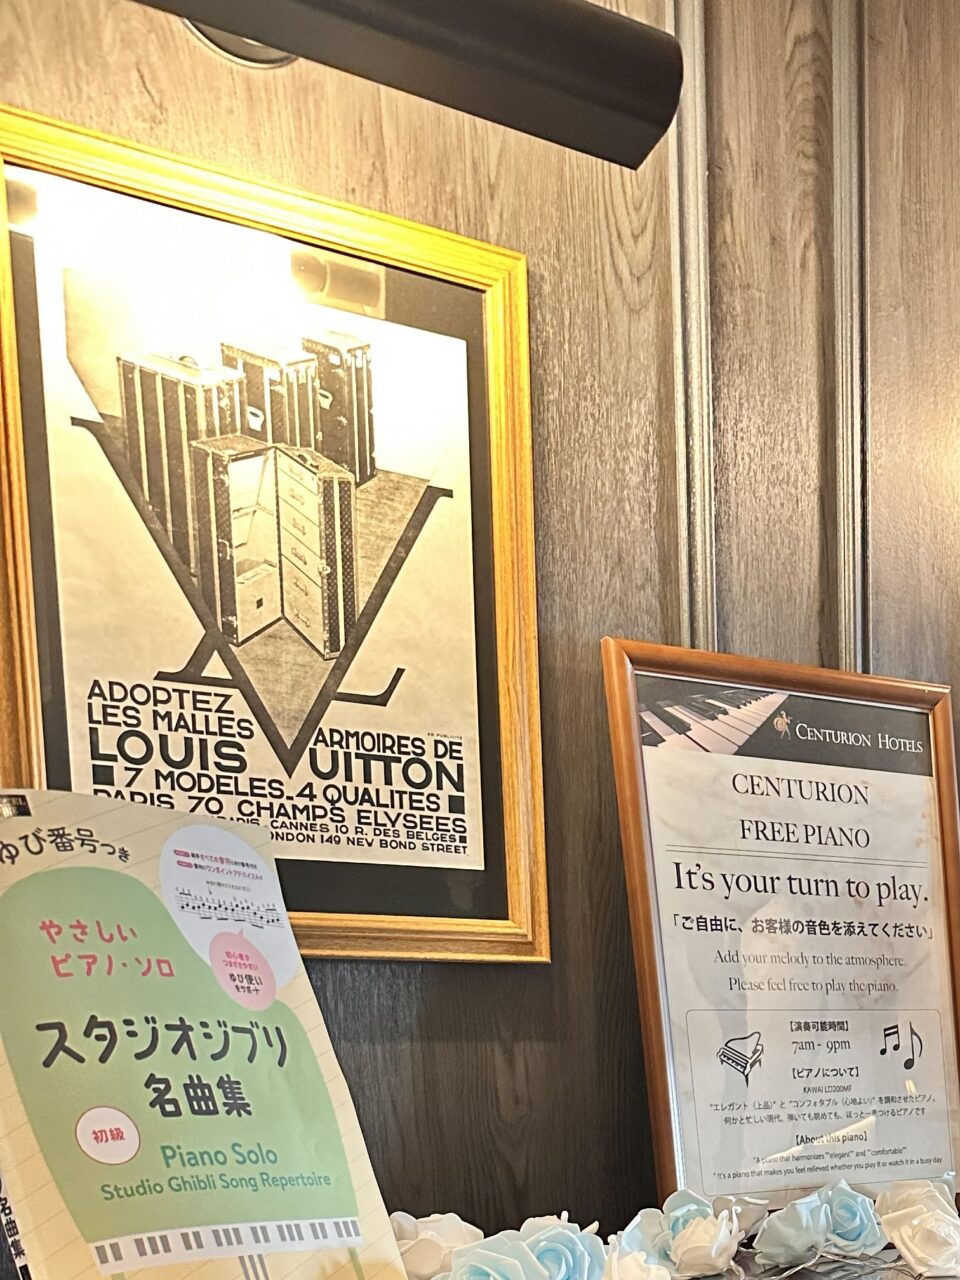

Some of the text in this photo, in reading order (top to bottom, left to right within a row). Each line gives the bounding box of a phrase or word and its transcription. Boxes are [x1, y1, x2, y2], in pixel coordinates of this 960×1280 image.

[88, 679, 235, 714] ADOPTEZ
[88, 702, 255, 740] LES MALLES
[89, 726, 249, 774] LOUIS
[313, 727, 464, 761] ARMOIRES DE
[795, 722, 923, 753] CENTURION HOTELS
[124, 767, 143, 788] 7
[322, 784, 441, 813] QUALITES
[731, 773, 869, 806] CENTURION
[187, 795, 224, 815] 70
[237, 798, 346, 824] CHAMPS
[356, 808, 468, 835] ELYSEES
[270, 819, 329, 833] CANNES
[335, 824, 349, 835] 10
[354, 825, 368, 836] R.
[373, 827, 401, 839] DES
[406, 830, 457, 843] BELGES
[320, 834, 341, 845] 149
[379, 838, 417, 851] BOND
[421, 842, 468, 855] STREET
[739, 818, 871, 849] FREE PIANO
[720, 873, 781, 900] your
[787, 875, 839, 898] turn
[847, 877, 871, 899] to
[876, 876, 929, 909] play.
[39, 919, 138, 946] やさしい
[50, 953, 176, 979] ピアノ・ソロ
[714, 950, 740, 963] Add
[742, 953, 768, 967] your
[770, 951, 809, 968] melody
[812, 954, 824, 965] to
[826, 952, 843, 966] the
[728, 977, 765, 991] Please
[767, 978, 786, 991] feel
[789, 978, 810, 991] free
[812, 980, 823, 991] to
[825, 978, 846, 995] play
[848, 979, 866, 992] the
[35, 1014, 287, 1068] スタジオジブリ
[792, 1040, 816, 1054] 7am
[826, 1040, 851, 1054] 9pm
[144, 1073, 253, 1118] 名曲集
[92, 1127, 126, 1145] 初級
[160, 1142, 278, 1169] Piano Solo
[101, 1171, 331, 1201] Studio Ghibli Song Repertoire
